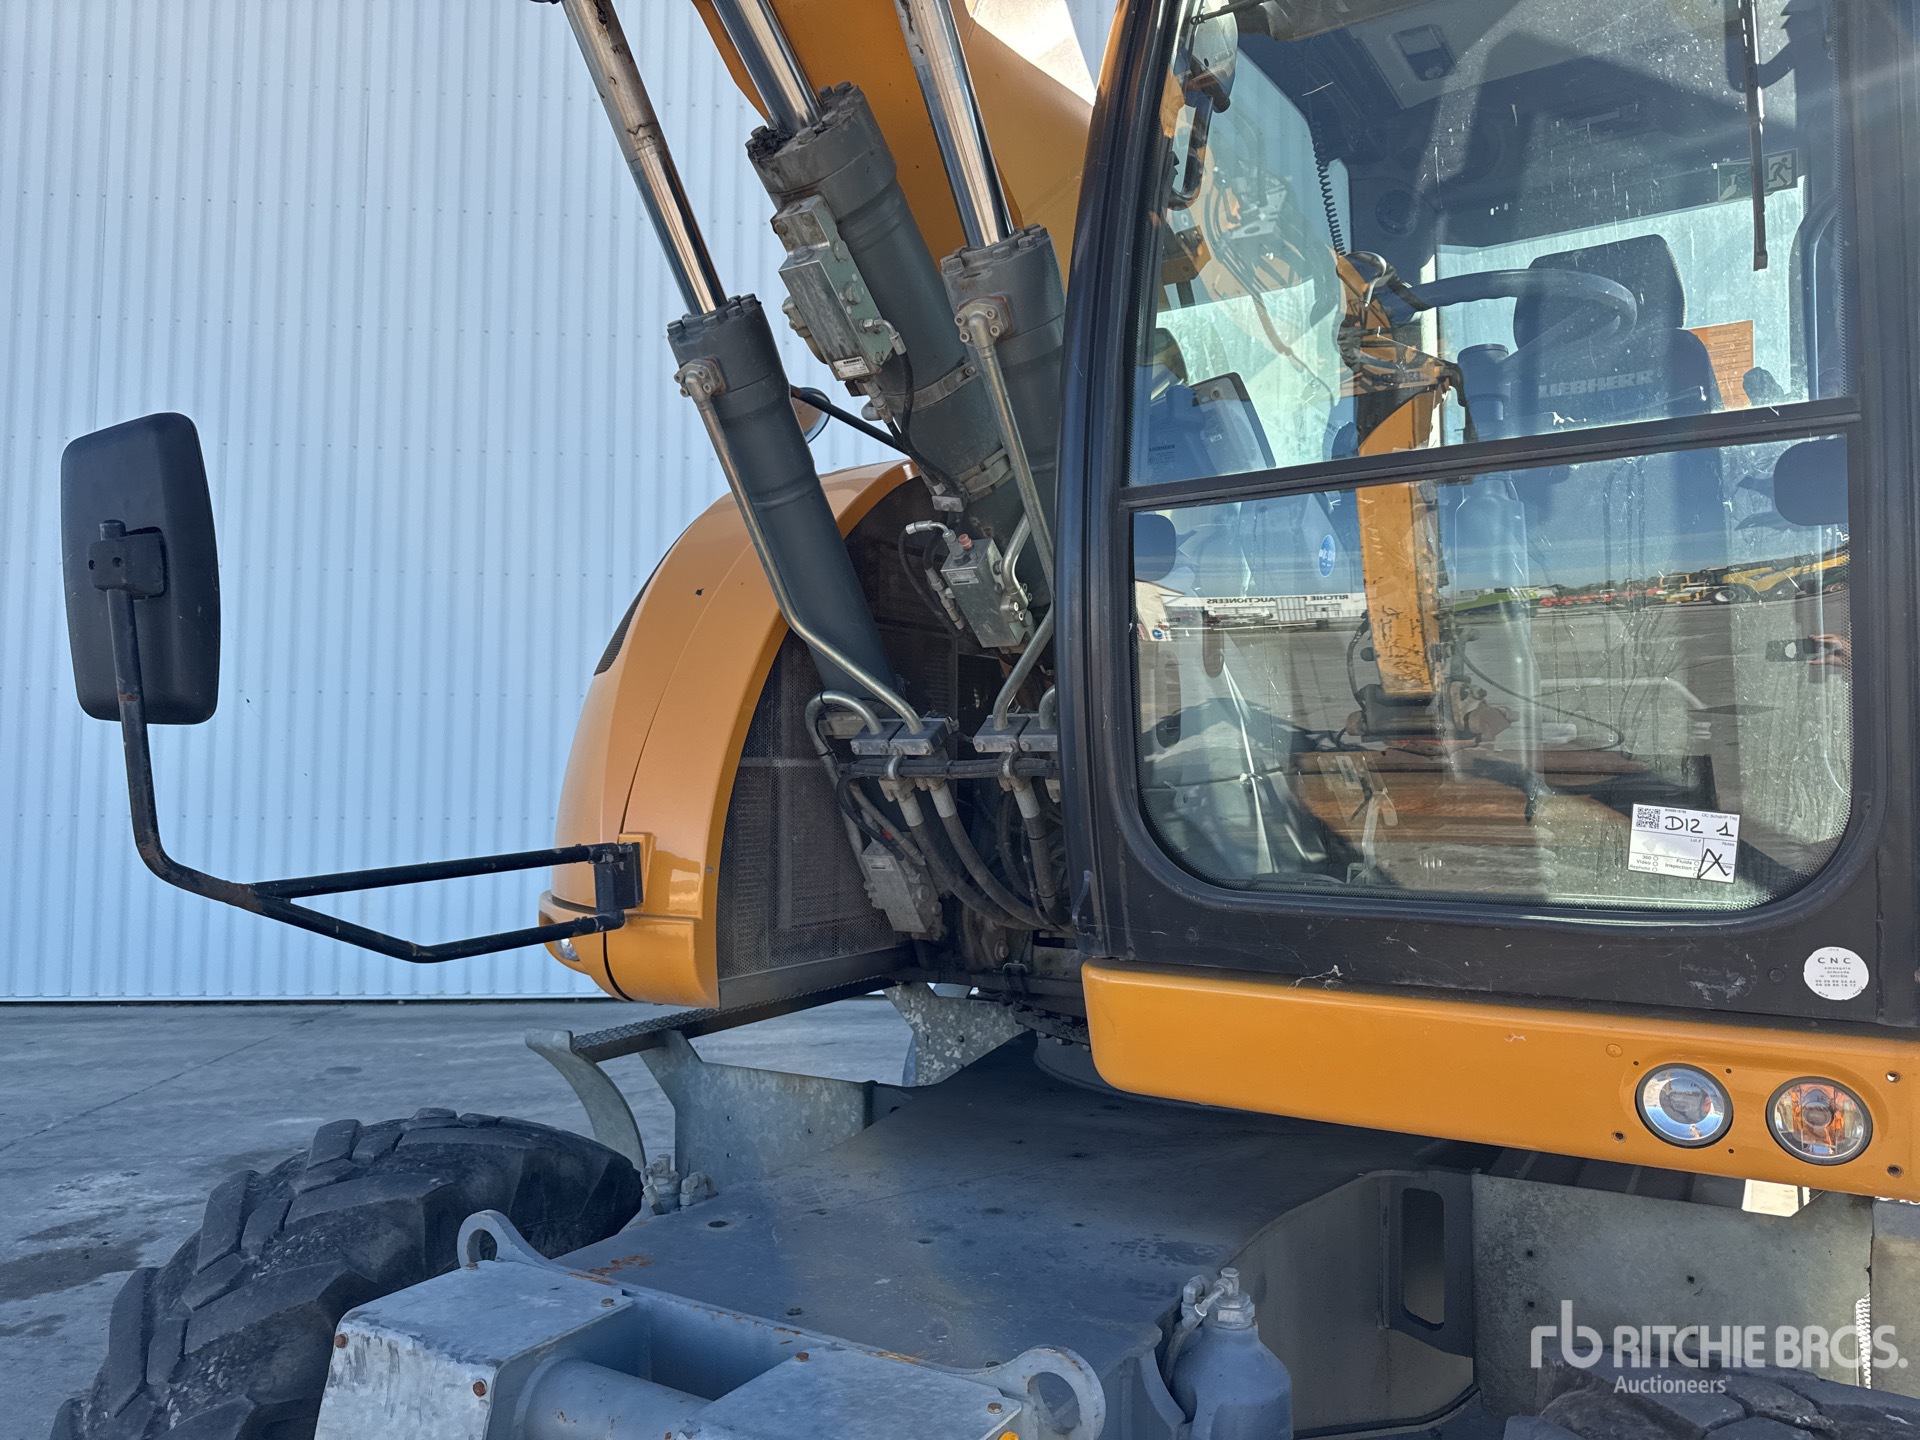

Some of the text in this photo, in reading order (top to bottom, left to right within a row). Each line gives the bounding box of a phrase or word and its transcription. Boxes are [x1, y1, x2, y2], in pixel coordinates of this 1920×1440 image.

[1538, 370, 1654, 399] LIEBHERR
[1716, 821, 1735, 837] 1
[1665, 863, 1693, 871] Inspection
